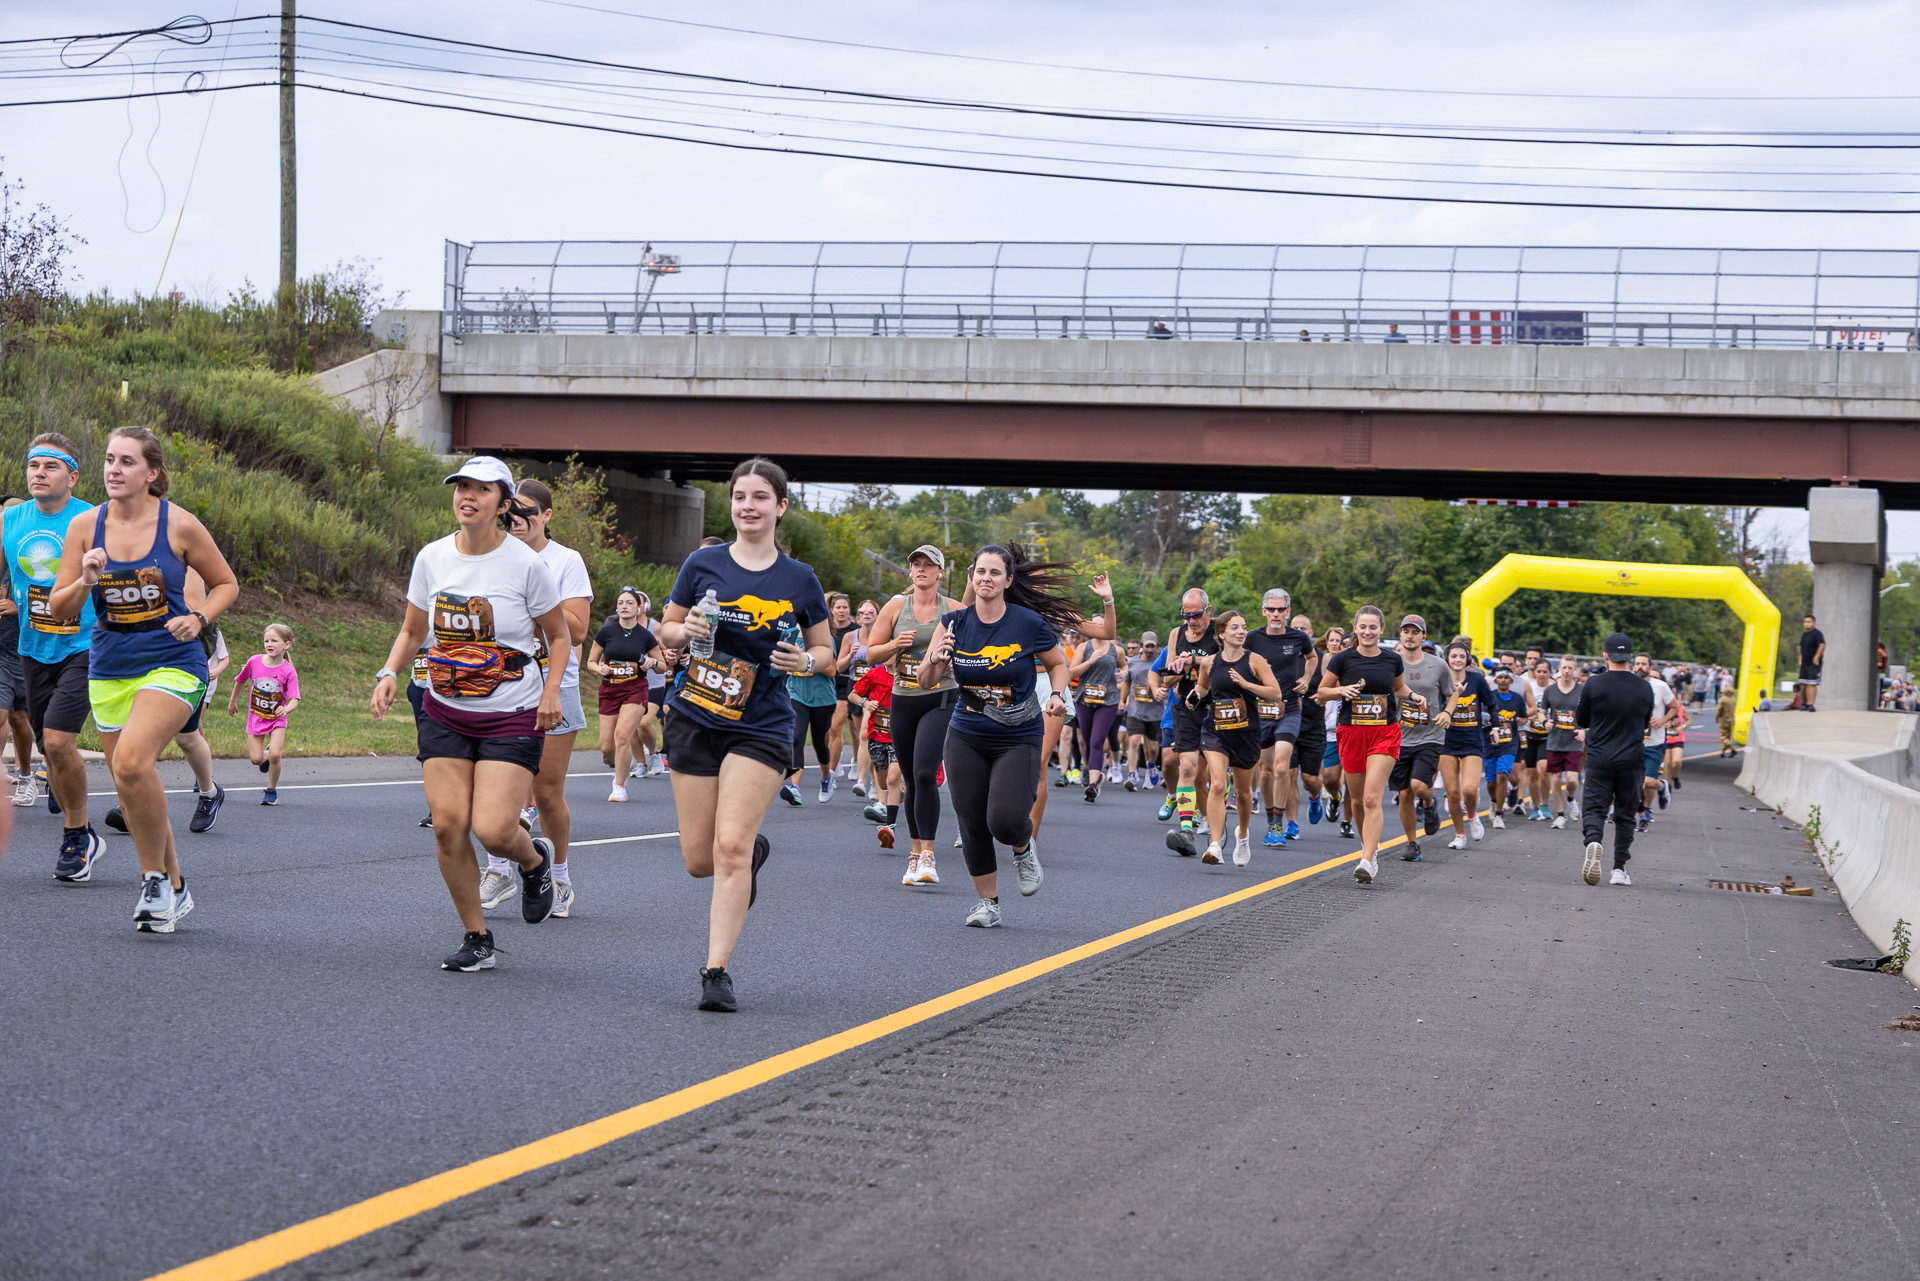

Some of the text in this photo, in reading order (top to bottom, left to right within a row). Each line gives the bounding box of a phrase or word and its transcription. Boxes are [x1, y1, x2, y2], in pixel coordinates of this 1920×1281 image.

[105, 584, 160, 603] 206
[437, 594, 448, 602] THE
[435, 602, 456, 611] CHASE
[442, 611, 481, 631] 101
[777, 620, 790, 629] 5K
[953, 656, 966, 664] THE
[613, 667, 634, 676] 102
[696, 664, 742, 696] 193
[255, 697, 278, 709] 167
[1220, 708, 1241, 719] 171
[1261, 706, 1280, 715] 112
[1356, 704, 1382, 714] 170
[1402, 709, 1428, 720] 342
